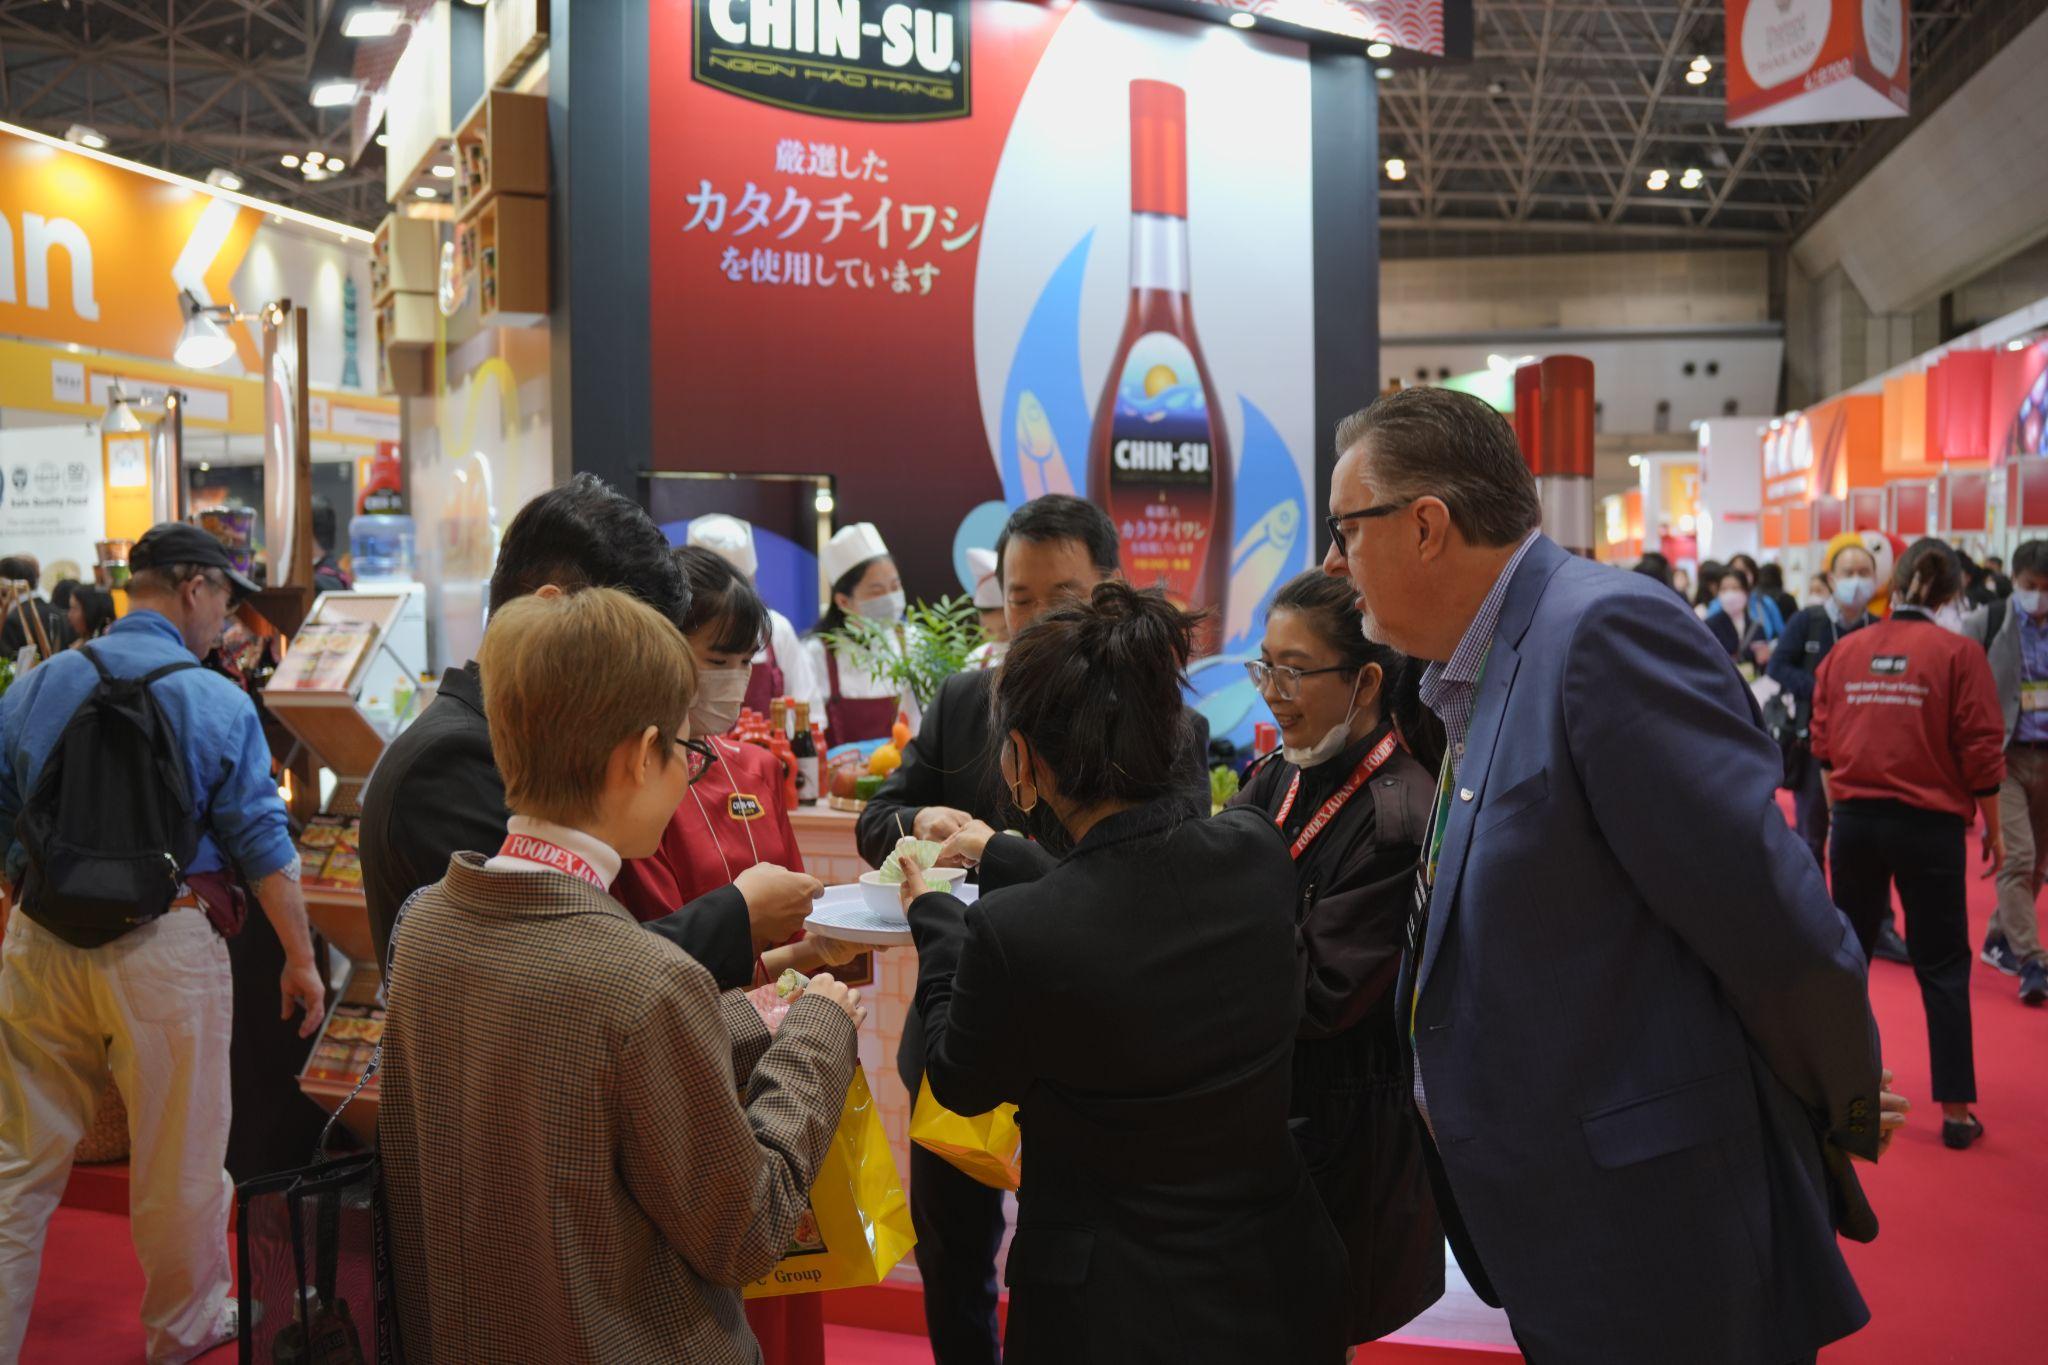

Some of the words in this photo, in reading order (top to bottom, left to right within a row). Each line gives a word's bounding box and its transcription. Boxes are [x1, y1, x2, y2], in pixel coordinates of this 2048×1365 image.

[709, 0, 954, 73] CHIN-SU
[775, 137, 889, 183] 厳選した
[682, 179, 979, 252] カタクチイワシ
[720, 245, 941, 296] を使用しています
[1114, 439, 1209, 472] CHIN-SU
[510, 836, 578, 874] FOODEX
[774, 1268, 822, 1283] Group
